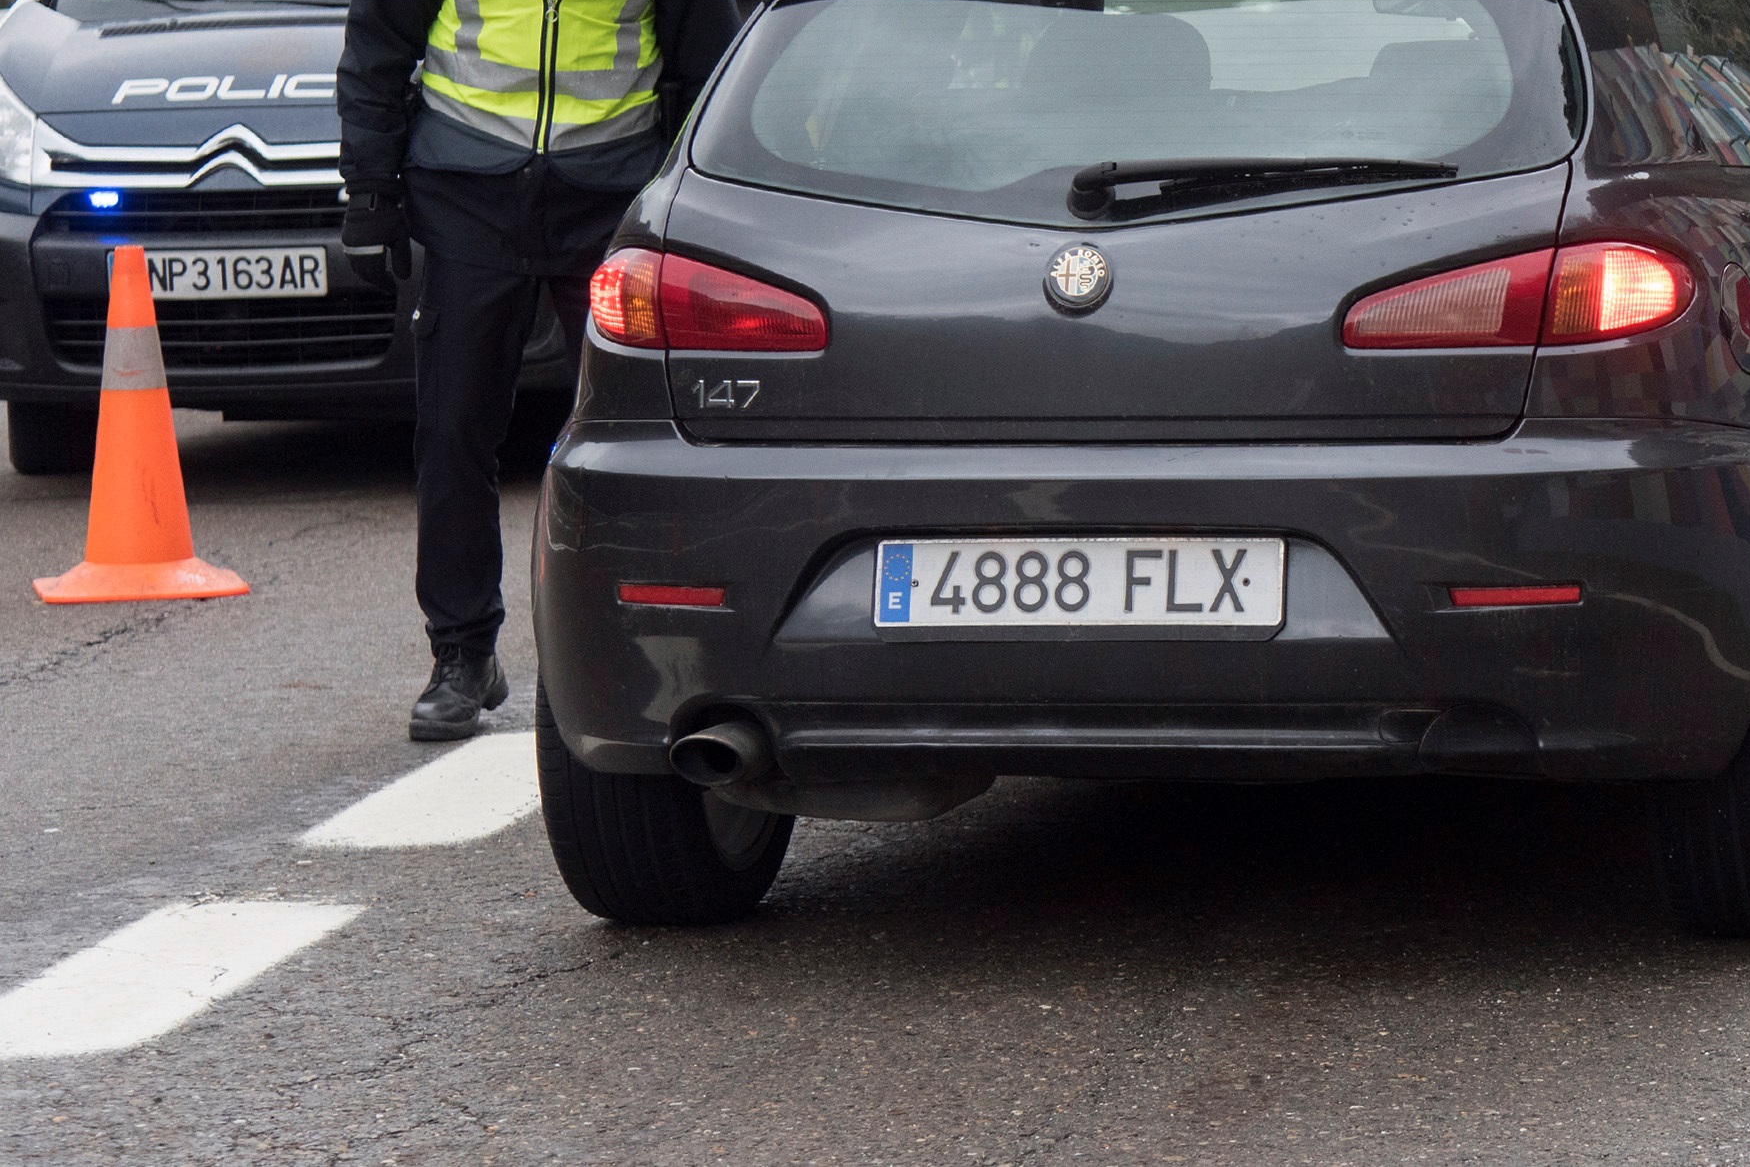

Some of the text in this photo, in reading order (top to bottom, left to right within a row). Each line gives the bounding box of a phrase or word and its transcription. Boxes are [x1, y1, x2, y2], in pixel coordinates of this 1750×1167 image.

[1050, 249, 1105, 278] ALFA ROMEO
[691, 379, 760, 409] 147
[887, 549, 1248, 614] E 4888 FLX
